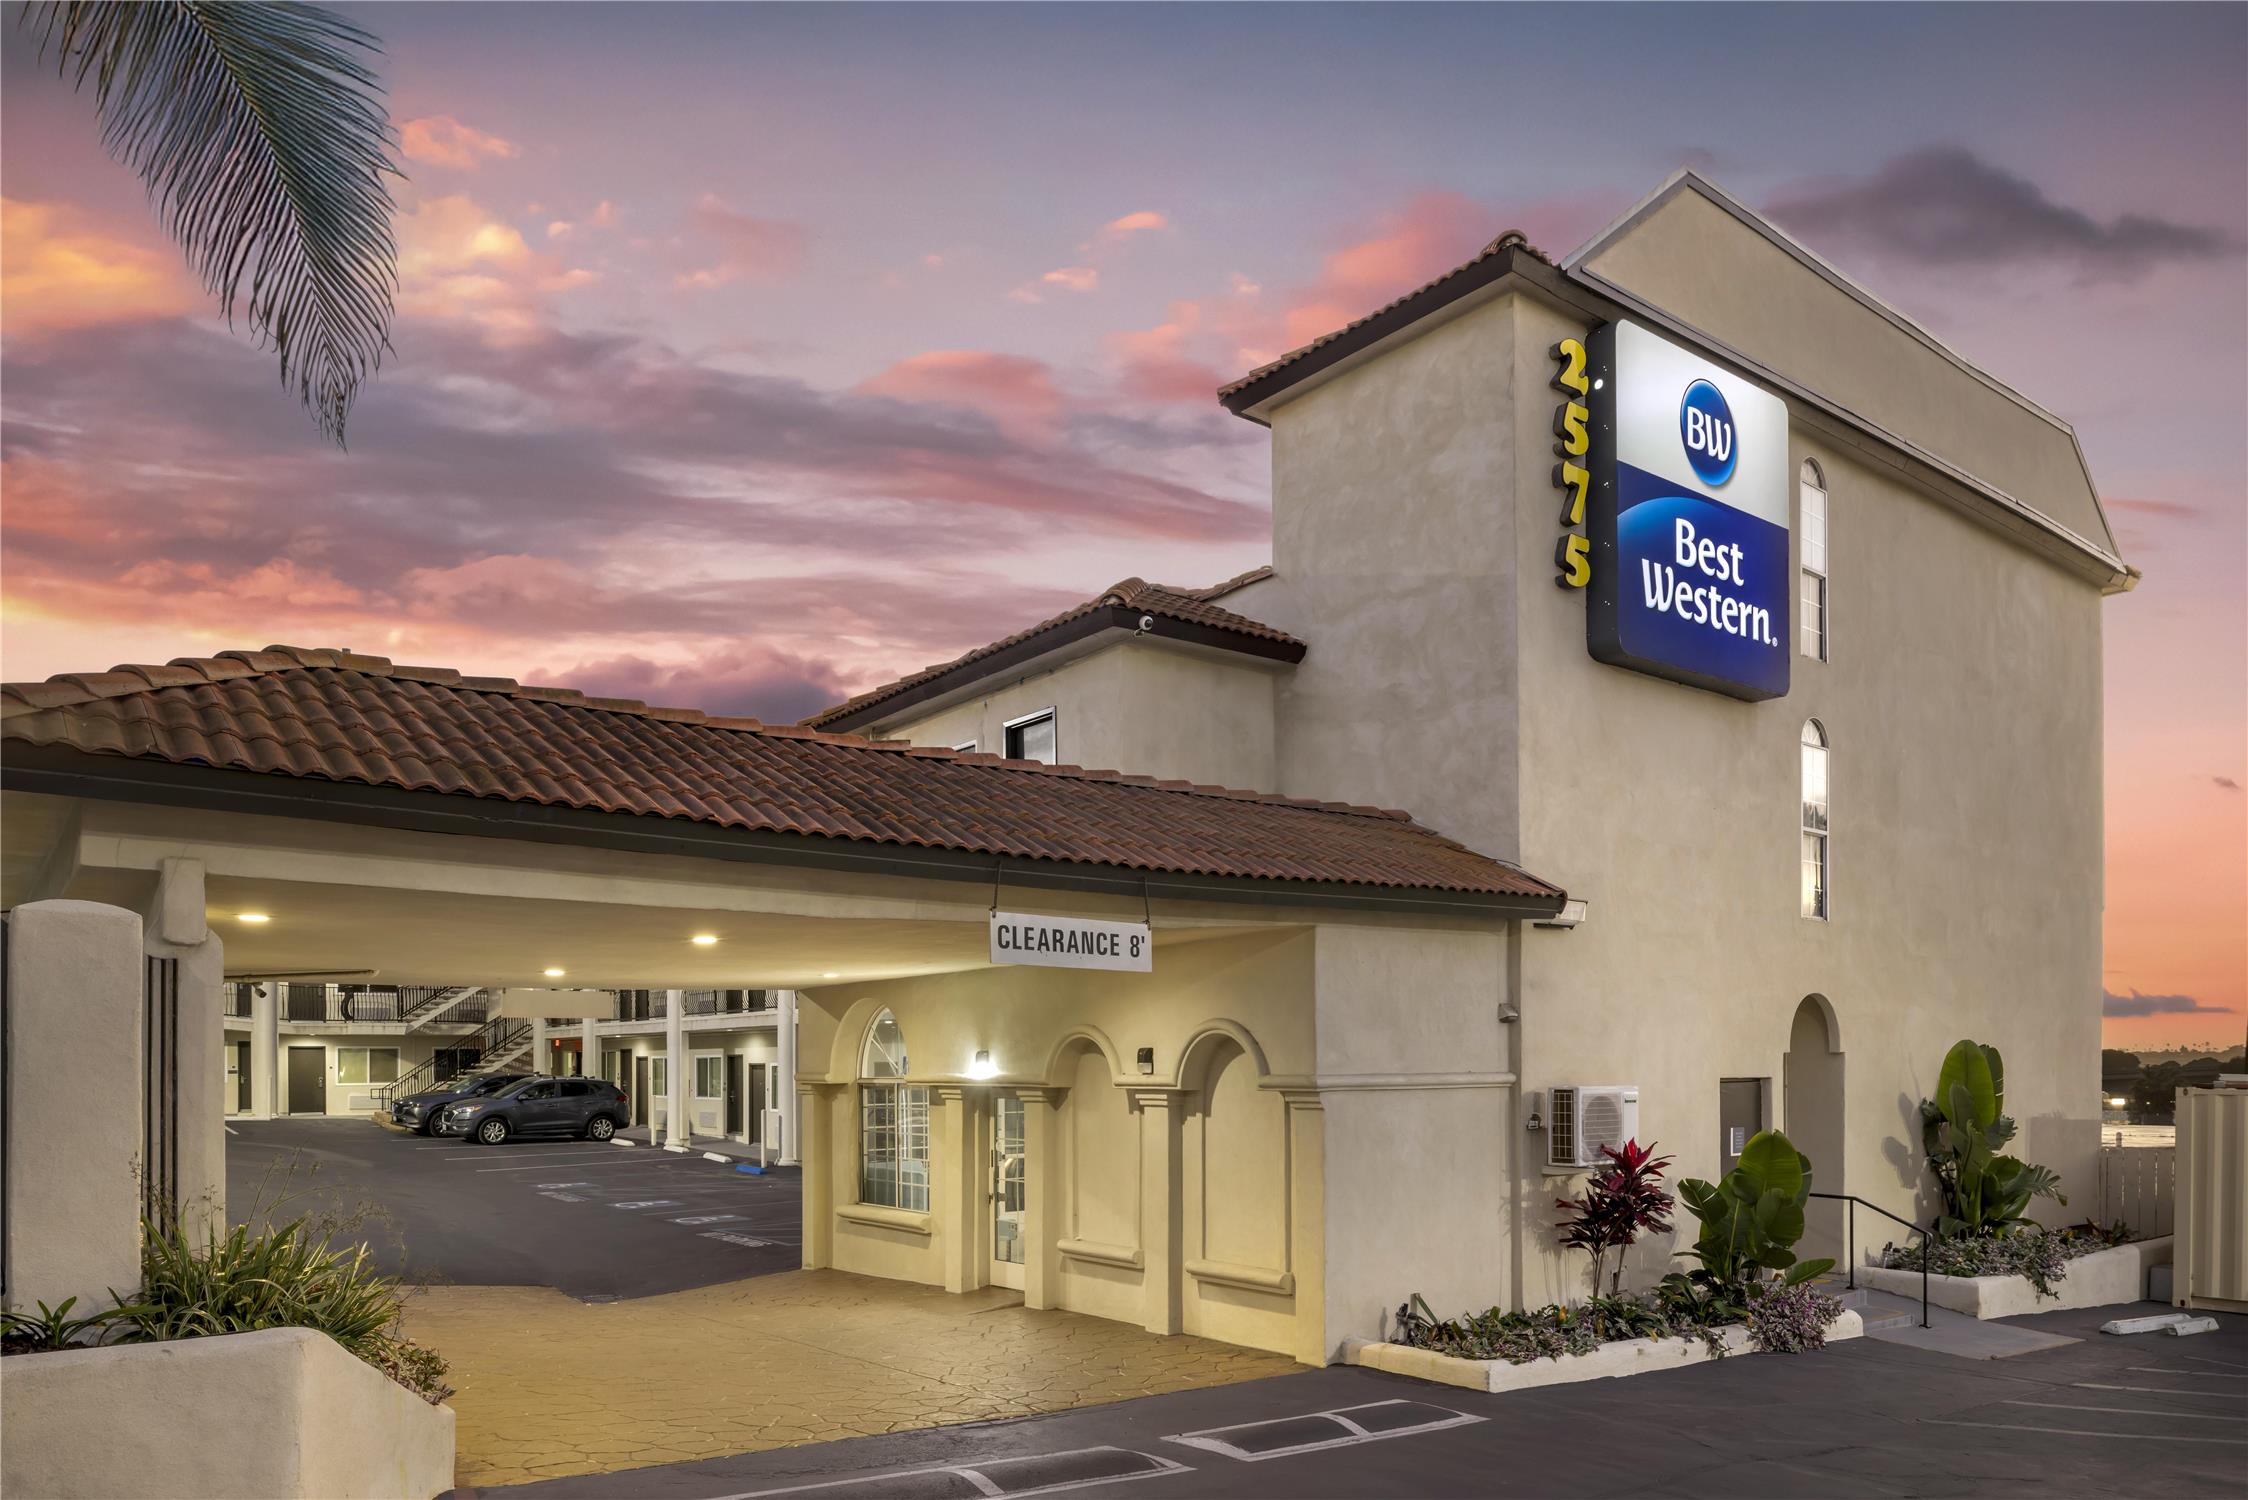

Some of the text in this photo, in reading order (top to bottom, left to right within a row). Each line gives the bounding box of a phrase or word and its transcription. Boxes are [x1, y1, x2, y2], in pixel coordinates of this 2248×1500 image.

[1554, 338, 1591, 588] 2575
[1686, 406, 1731, 462] BW
[1675, 517, 1744, 587] Best
[997, 924, 1146, 958] CLEARANCE 8'
